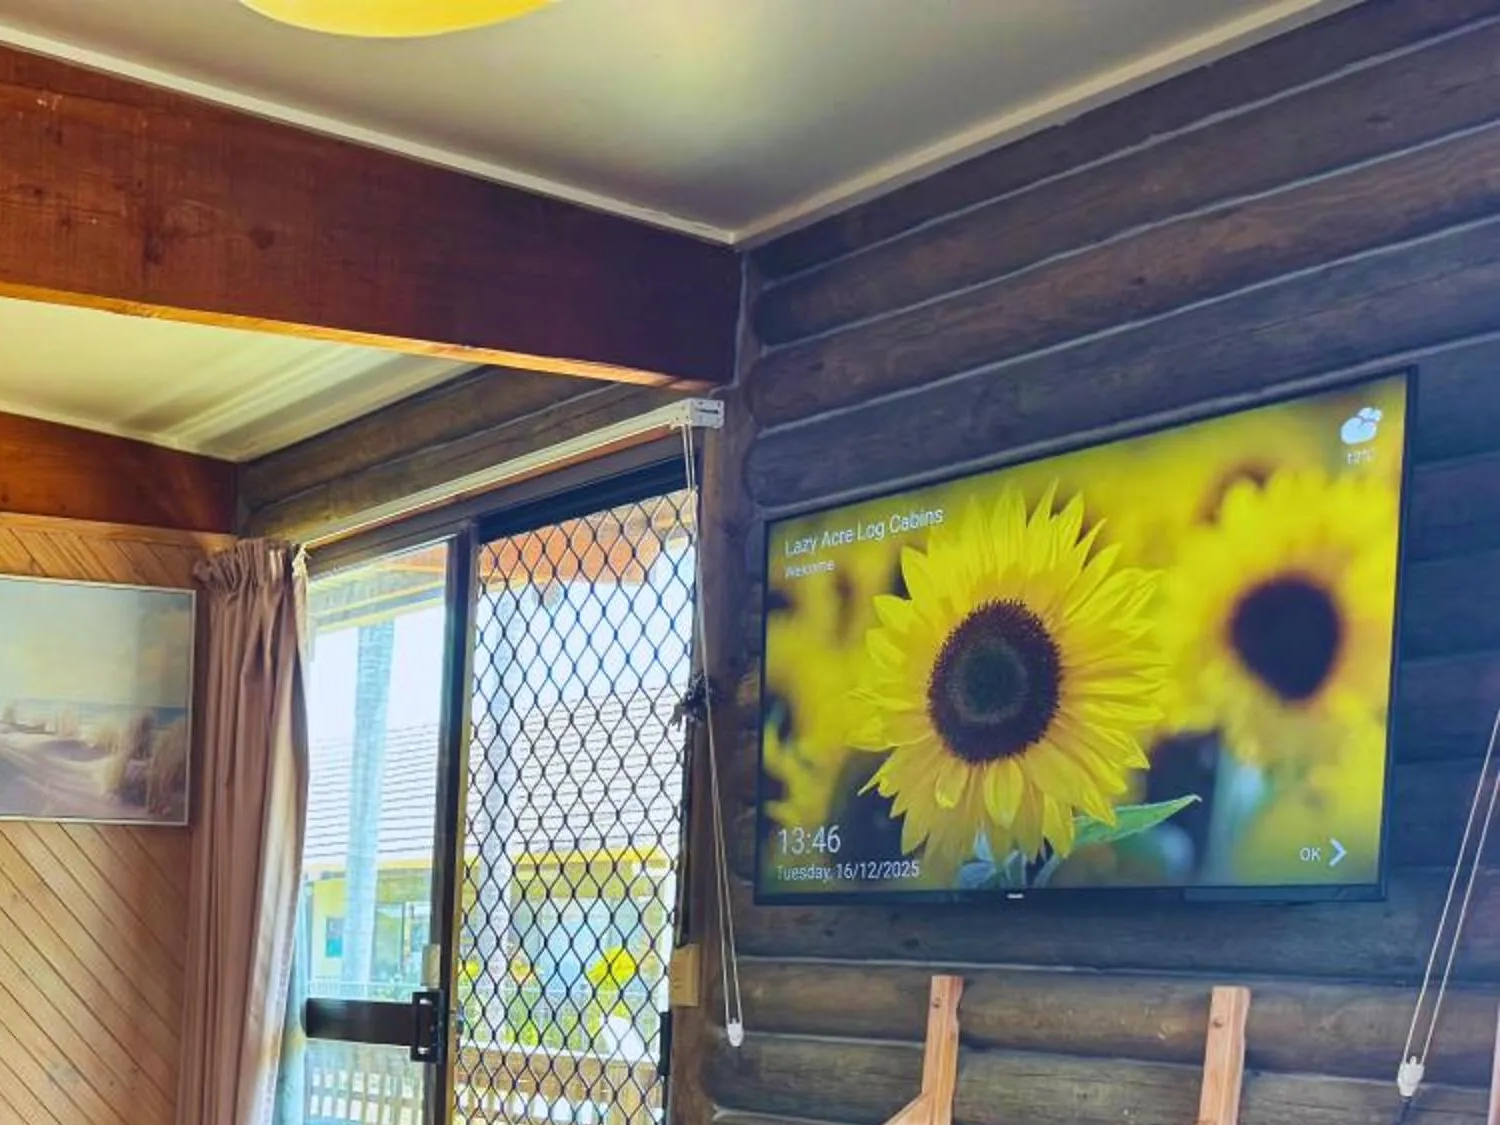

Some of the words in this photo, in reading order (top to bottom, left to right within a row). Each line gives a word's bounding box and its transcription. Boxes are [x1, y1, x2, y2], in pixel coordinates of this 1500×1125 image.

[785, 537, 817, 557] Lazy
[821, 529, 853, 548] Acre
[857, 520, 885, 541] Log
[889, 508, 944, 534] Cabins
[778, 825, 842, 855] 13:46
[1300, 847, 1321, 861] OK
[835, 860, 921, 880] 16/12/2025
